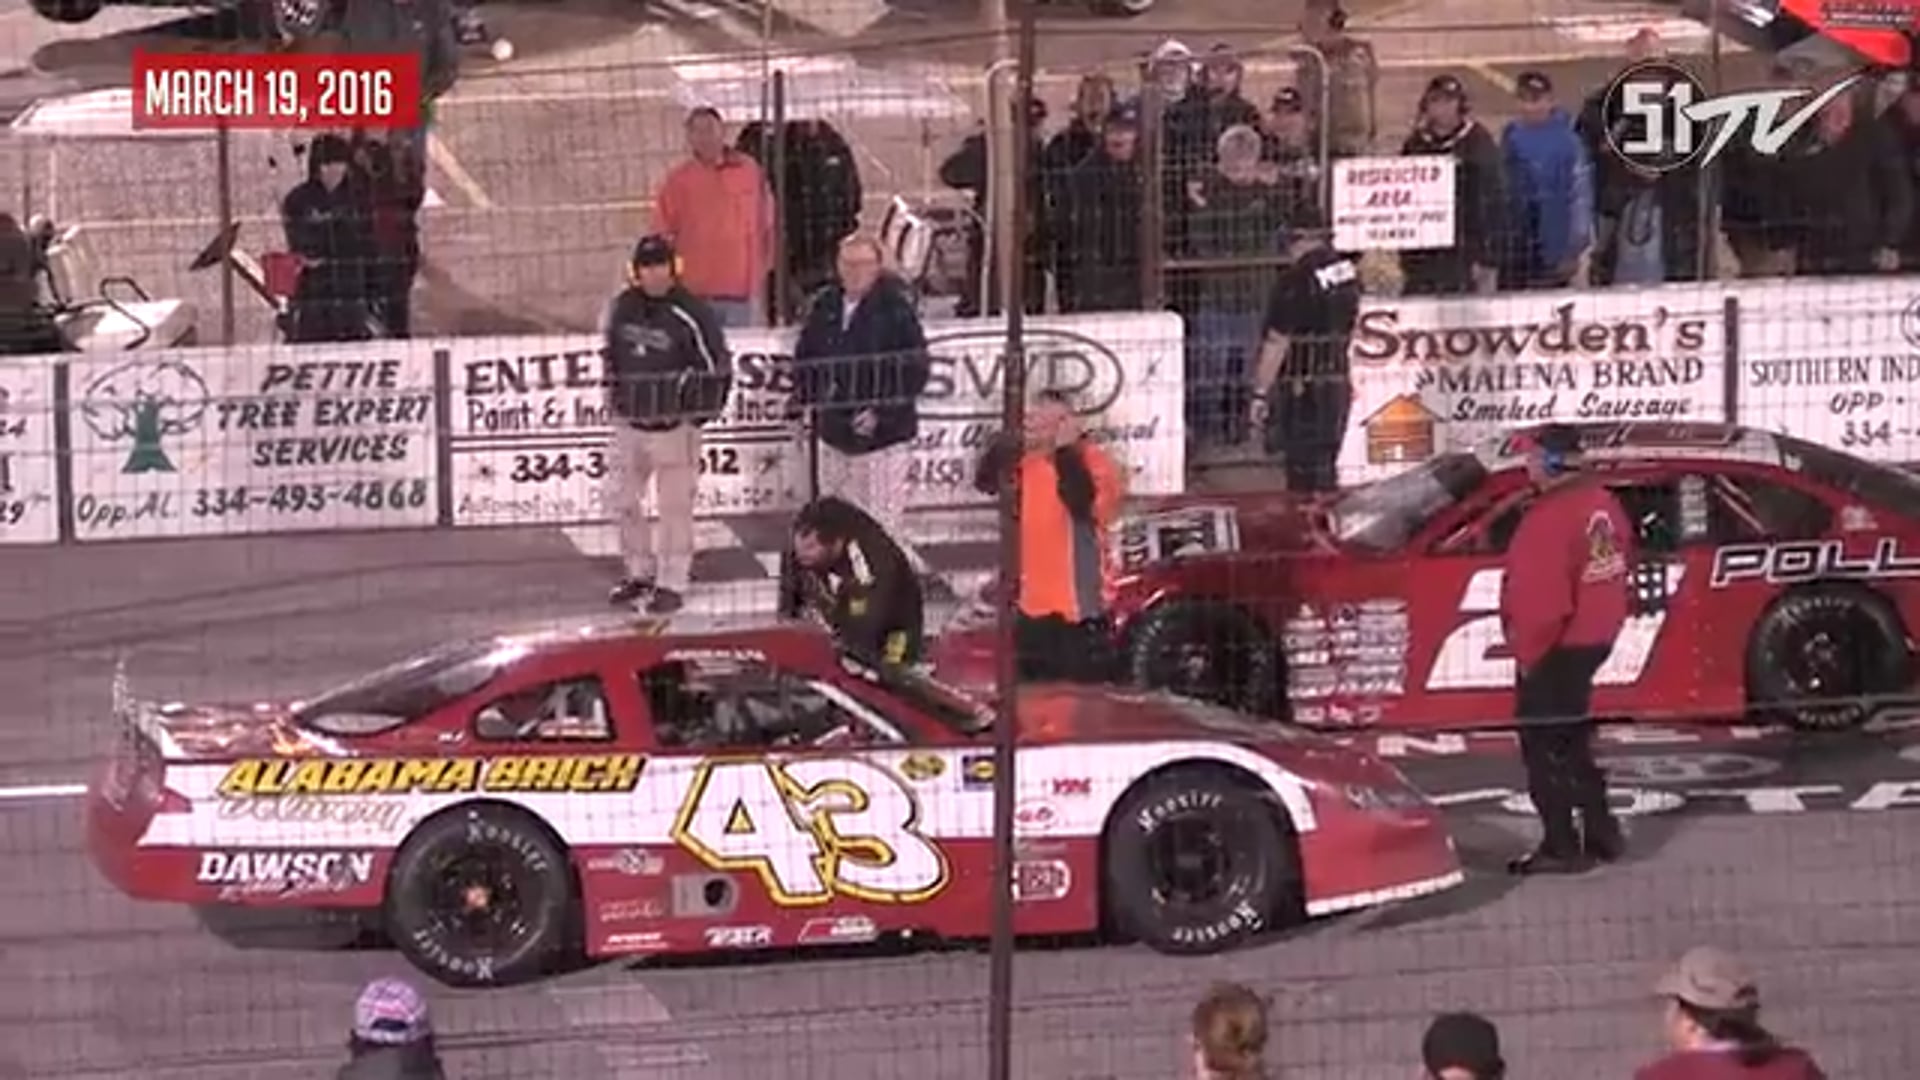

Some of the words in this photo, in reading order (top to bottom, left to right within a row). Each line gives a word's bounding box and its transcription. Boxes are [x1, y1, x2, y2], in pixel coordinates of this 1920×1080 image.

[1353, 303, 1706, 361] Snowden's
[261, 359, 401, 392] PETTIE
[1438, 360, 1577, 393] MALENA
[1592, 355, 1705, 388] BRAND
[1750, 356, 1872, 388] SOUTHERN
[217, 401, 300, 430] TREE
[314, 395, 432, 426] EXPERT
[468, 400, 538, 431] Paint
[1576, 391, 1692, 422] Sausage
[1828, 390, 1885, 415] OPP
[253, 433, 409, 467] SERVICES
[192, 481, 428, 517] 334-493-4868
[217, 756, 480, 797] ALABAMA
[670, 755, 951, 906] 43
[196, 851, 374, 883] DAWSON
